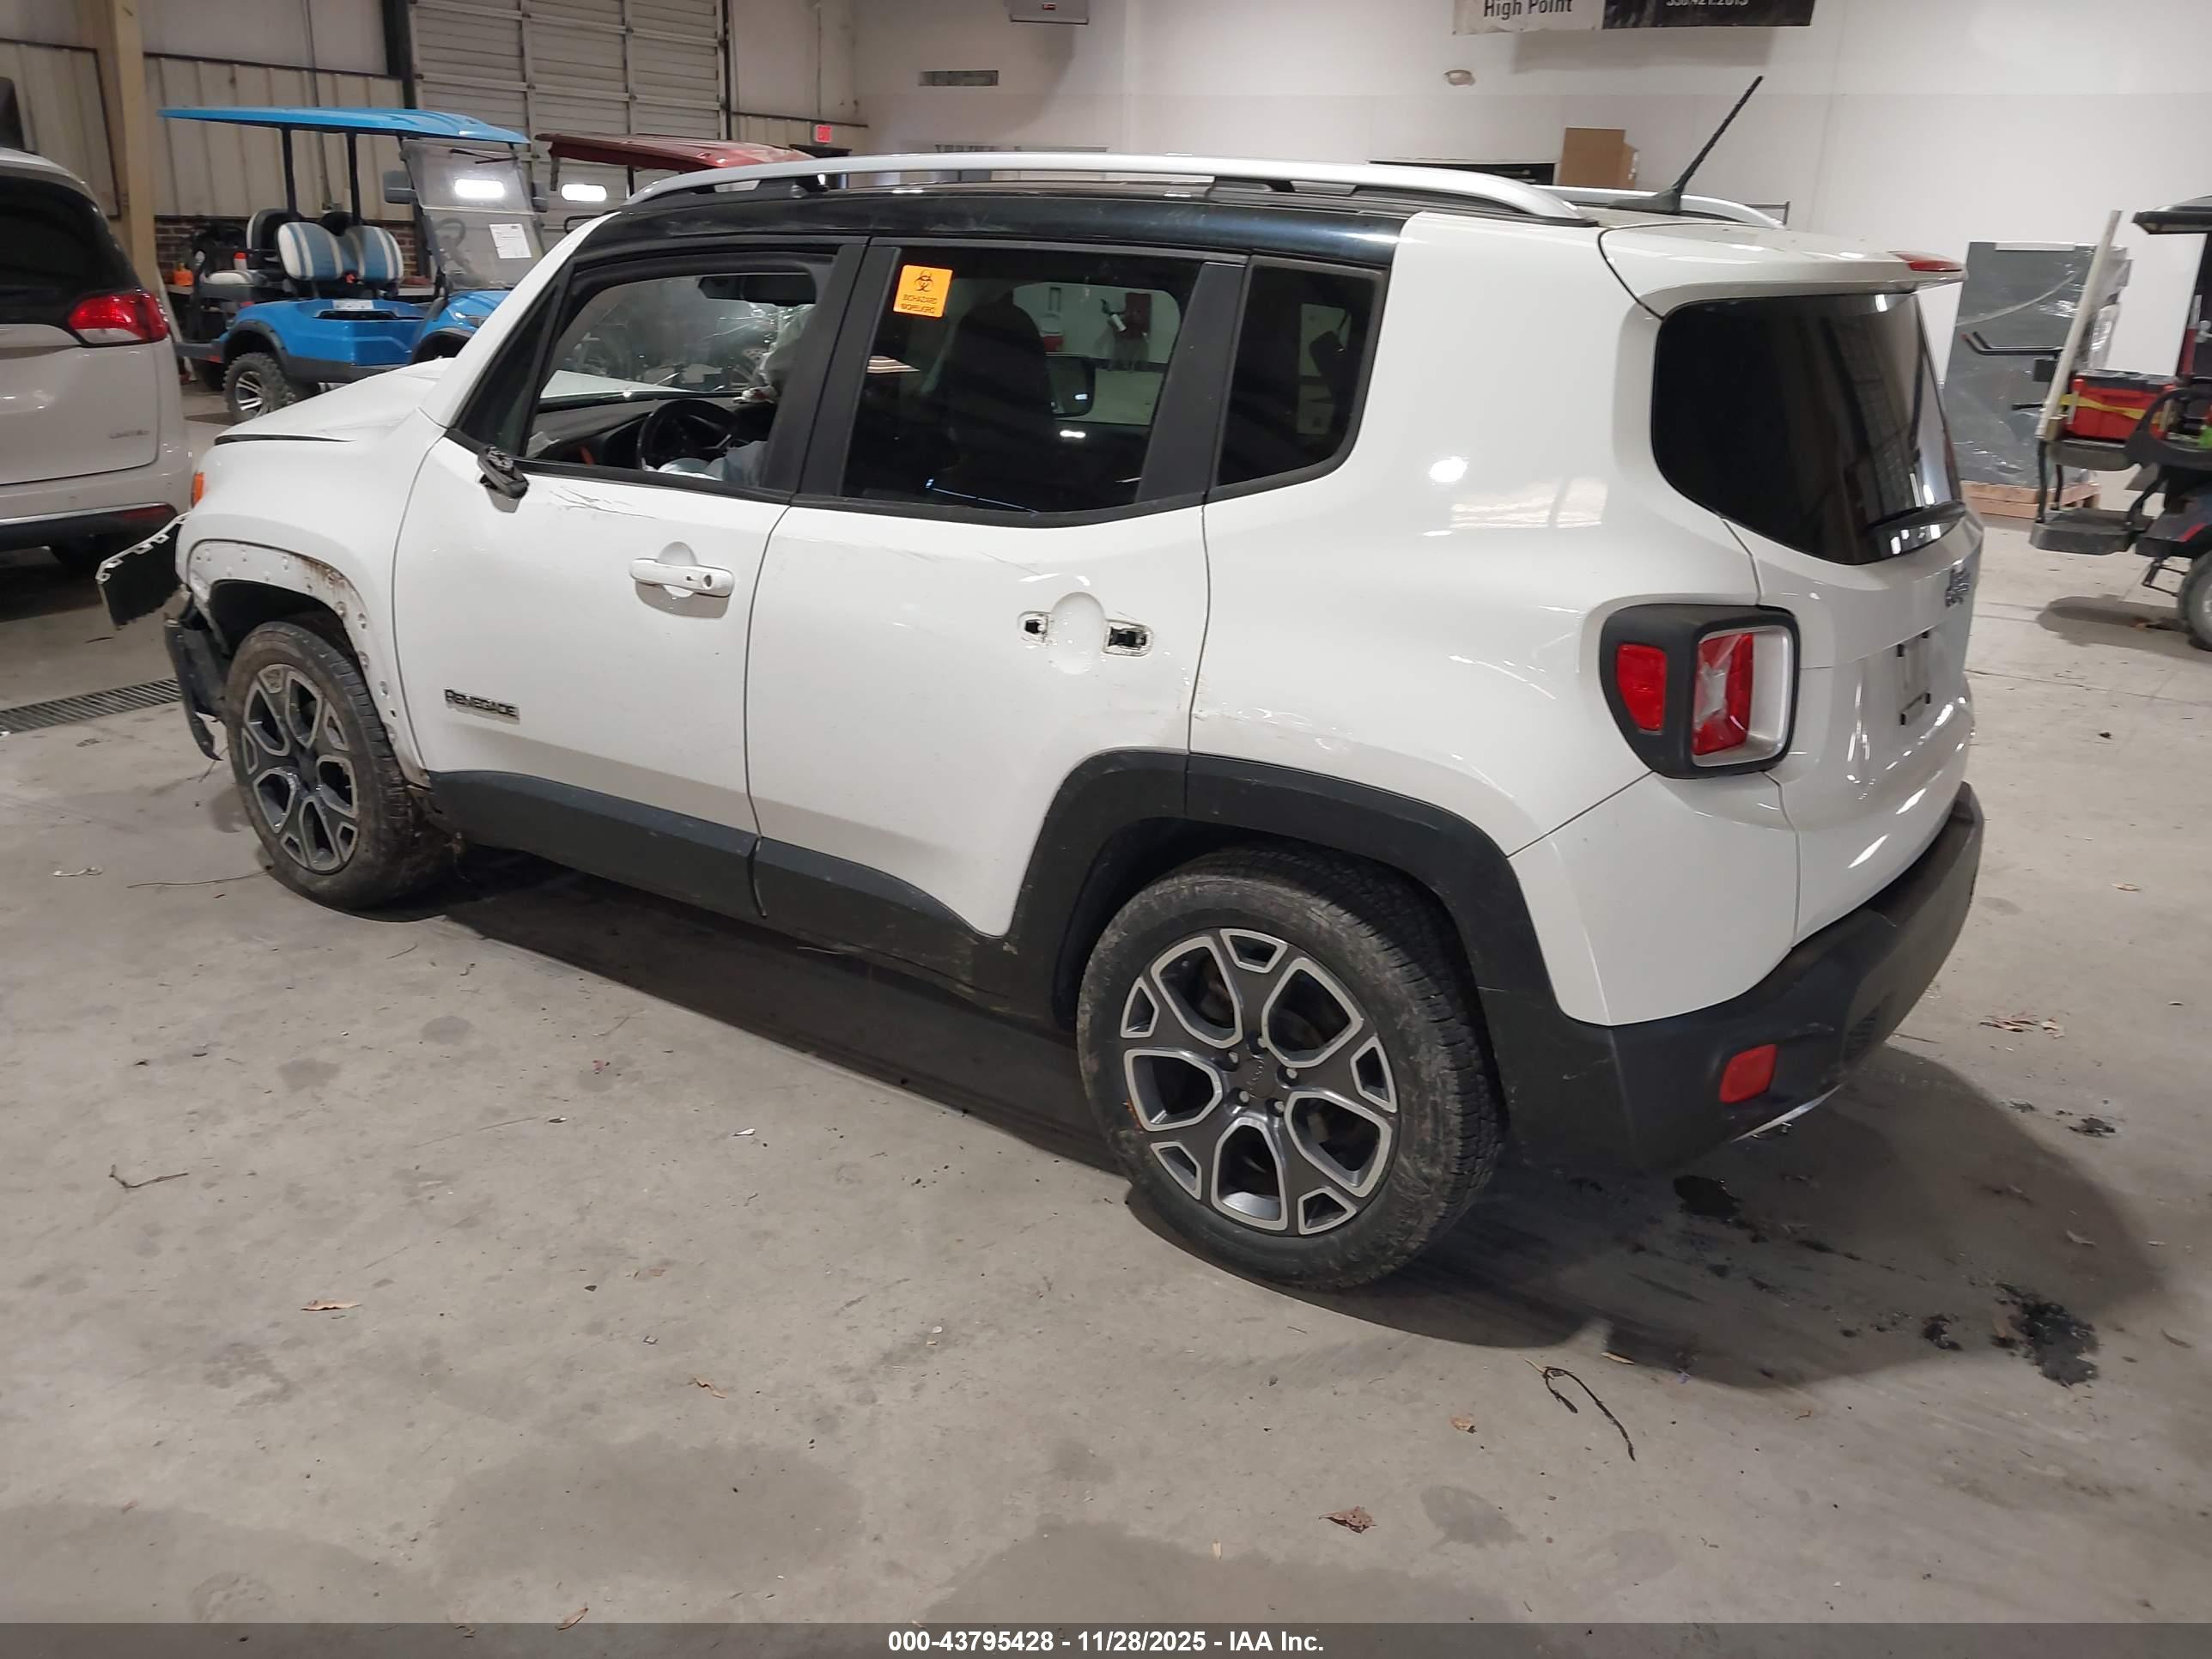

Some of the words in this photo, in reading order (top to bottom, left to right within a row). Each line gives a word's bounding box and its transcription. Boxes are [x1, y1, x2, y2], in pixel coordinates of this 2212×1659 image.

[1483, 0, 1522, 21] High
[1528, 0, 1572, 14] Point
[444, 688, 520, 720] RENEGADE
